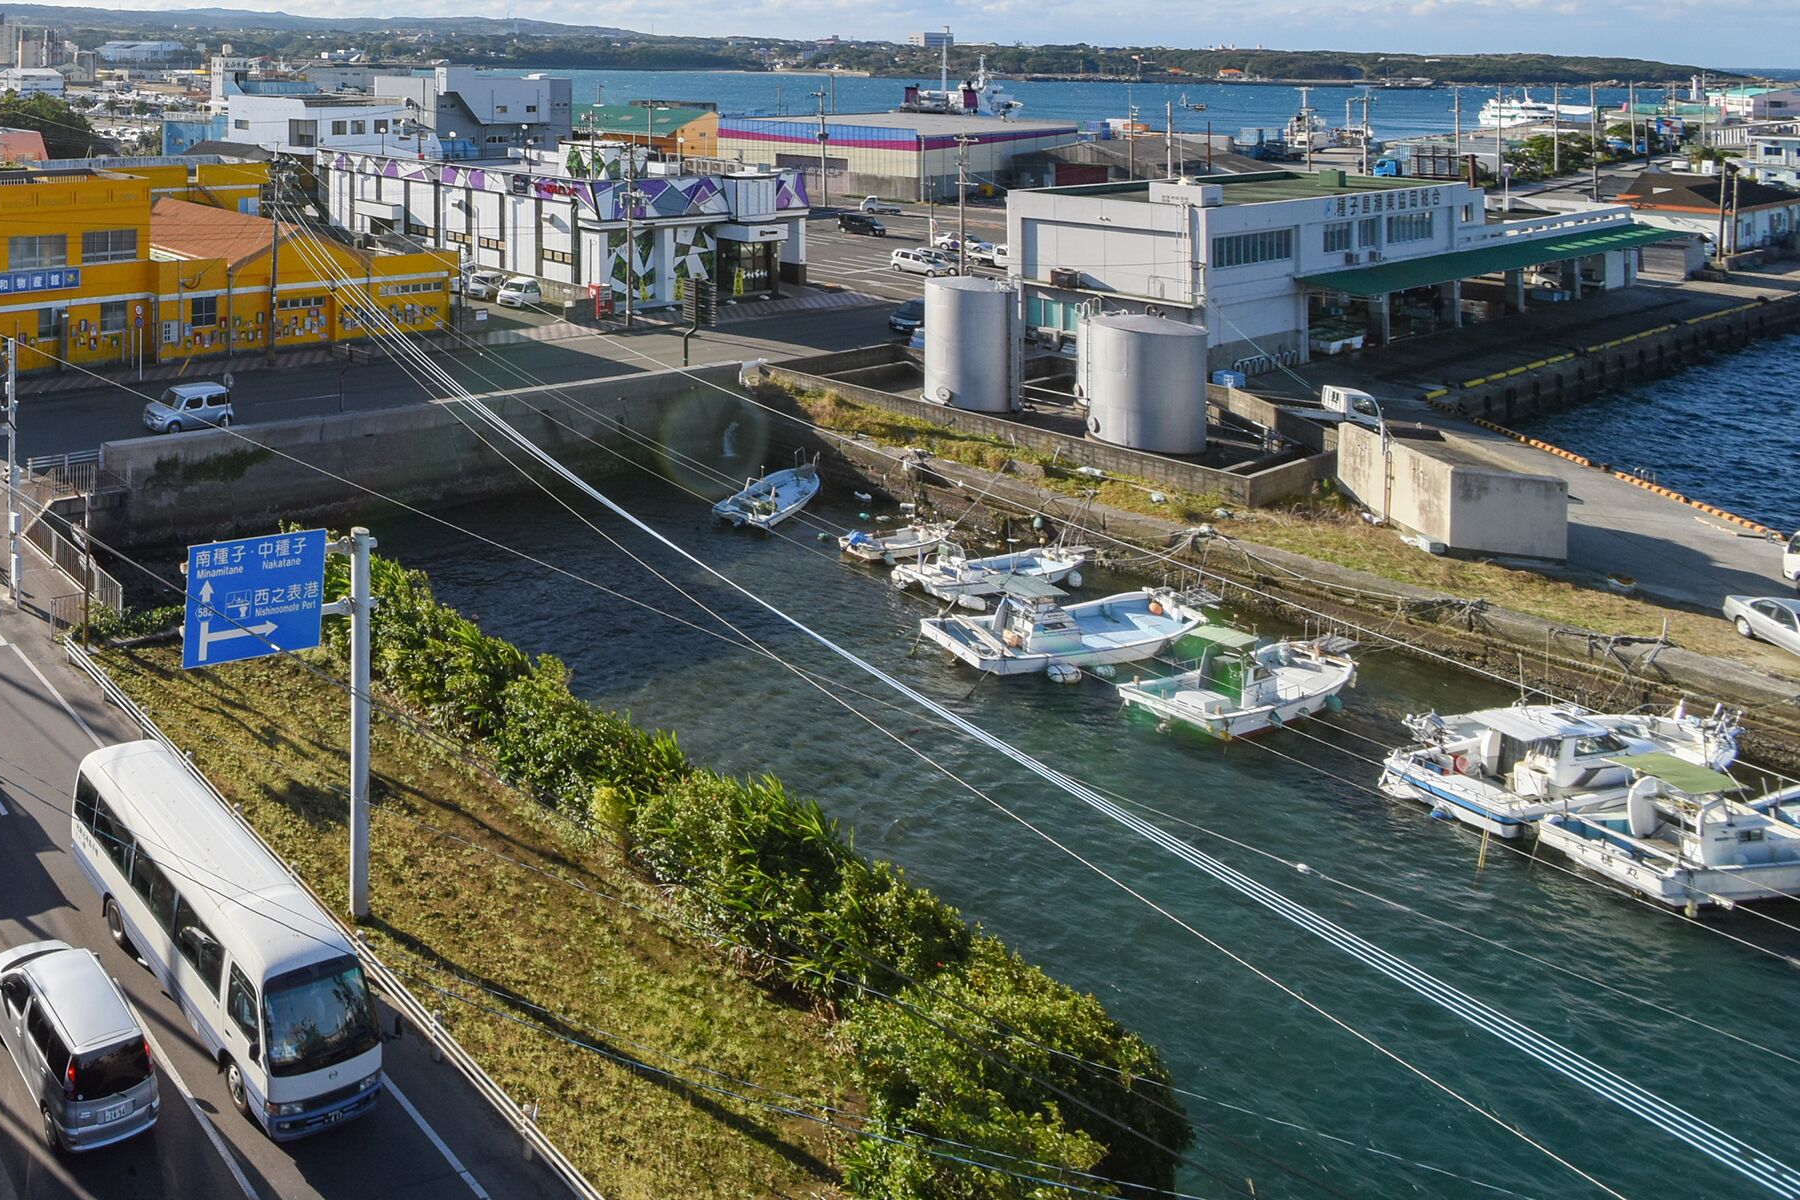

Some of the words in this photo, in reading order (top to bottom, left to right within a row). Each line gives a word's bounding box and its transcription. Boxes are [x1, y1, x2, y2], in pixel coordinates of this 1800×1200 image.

[1336, 188, 1441, 218] 種子島漁業協同組合
[196, 565, 244, 580] Minamitane
[262, 557, 301, 570] Nakatane
[254, 581, 319, 606] 西之表港
[255, 603, 300, 617] Nishinoomote
[302, 599, 316, 610] Port
